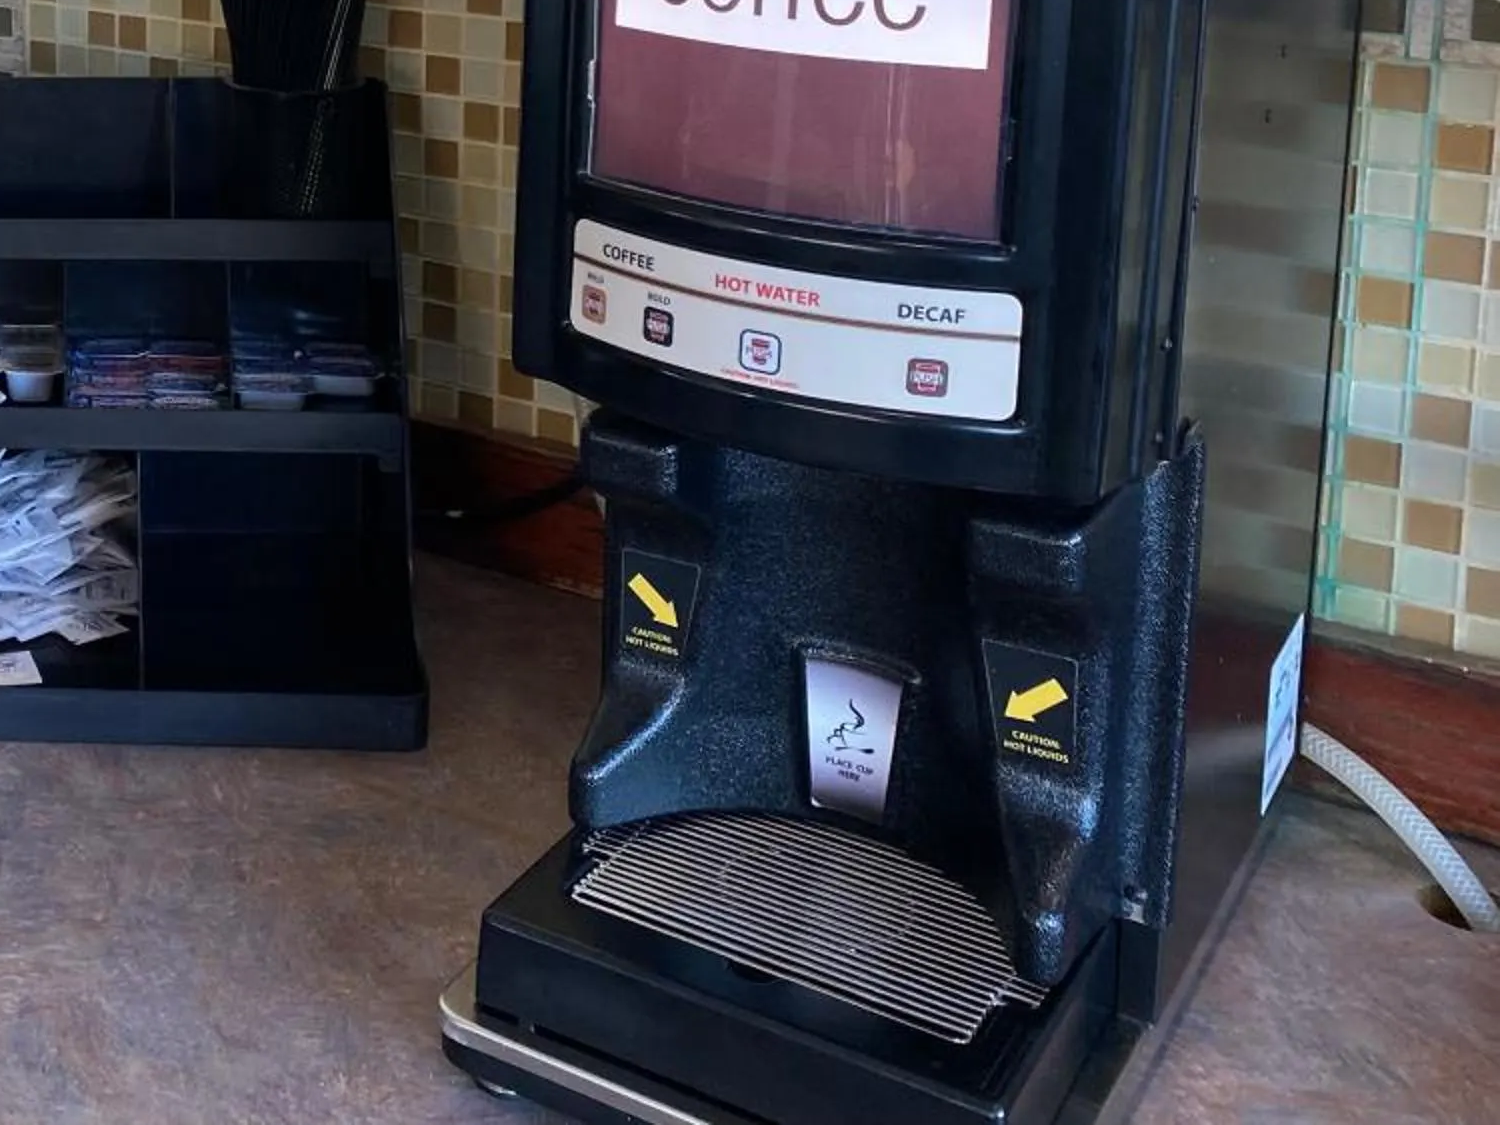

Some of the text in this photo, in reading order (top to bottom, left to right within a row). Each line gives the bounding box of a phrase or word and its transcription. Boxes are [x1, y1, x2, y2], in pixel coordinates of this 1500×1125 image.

[602, 243, 656, 272] COFFEE
[714, 273, 820, 307] HOT WATER
[897, 303, 966, 324] DECAF
[625, 634, 643, 647] HOT
[1003, 739, 1070, 764] HOT LIQUIDS
